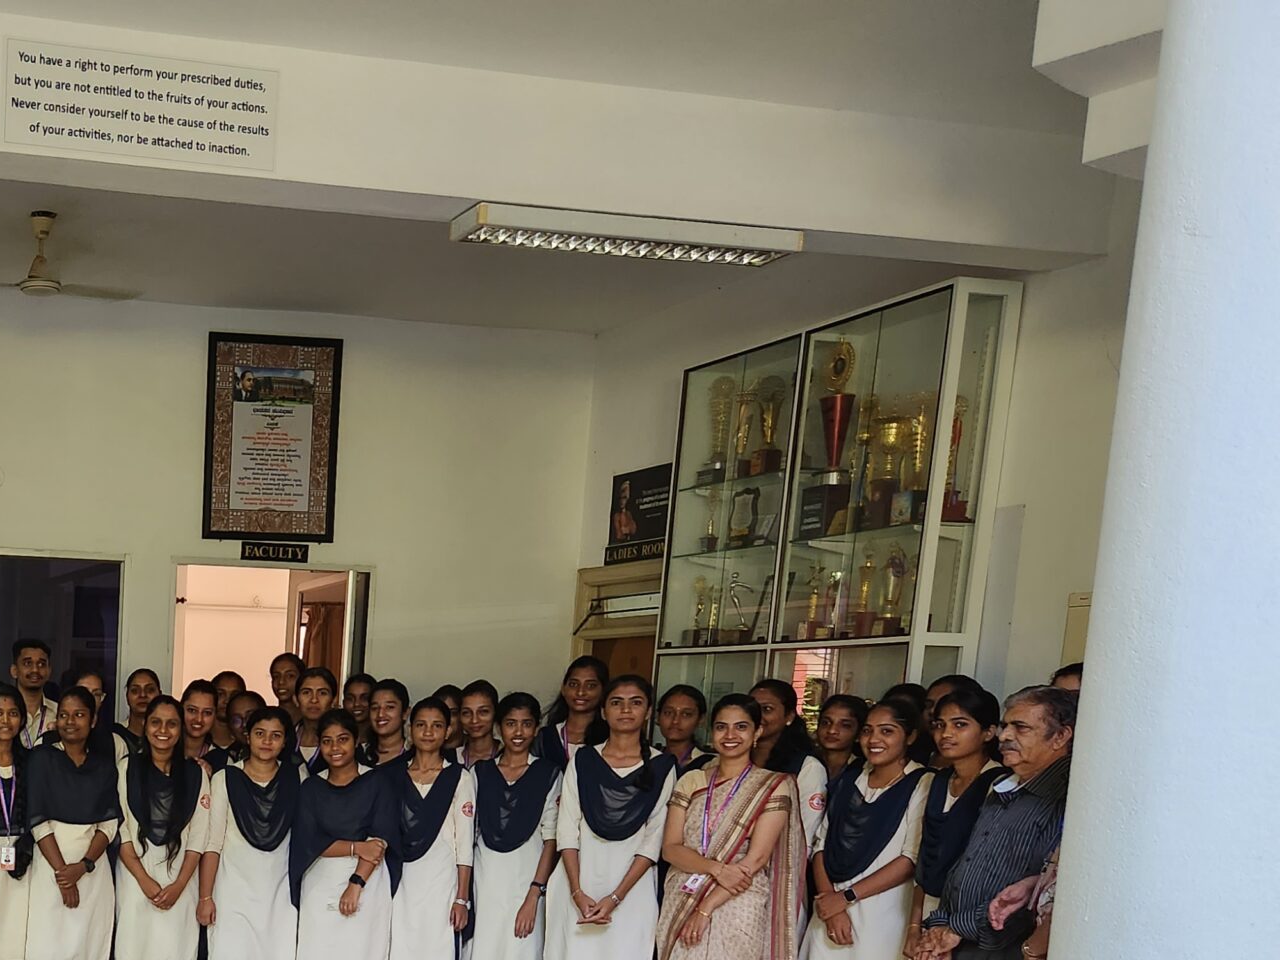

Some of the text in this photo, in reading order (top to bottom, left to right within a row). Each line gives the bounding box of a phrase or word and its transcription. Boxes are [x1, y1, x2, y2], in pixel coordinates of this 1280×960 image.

[18, 51, 265, 92] You have a right to perform your prescribed duties,
[14, 73, 267, 113] but you are not entitled to the fruits of your actions.
[11, 96, 269, 136] Never consider yourself to be the cause of the results
[29, 122, 249, 156] of your activities, nor be attached to inaction.
[245, 545, 305, 559] FACULTY
[606, 546, 638, 561] LADIES
